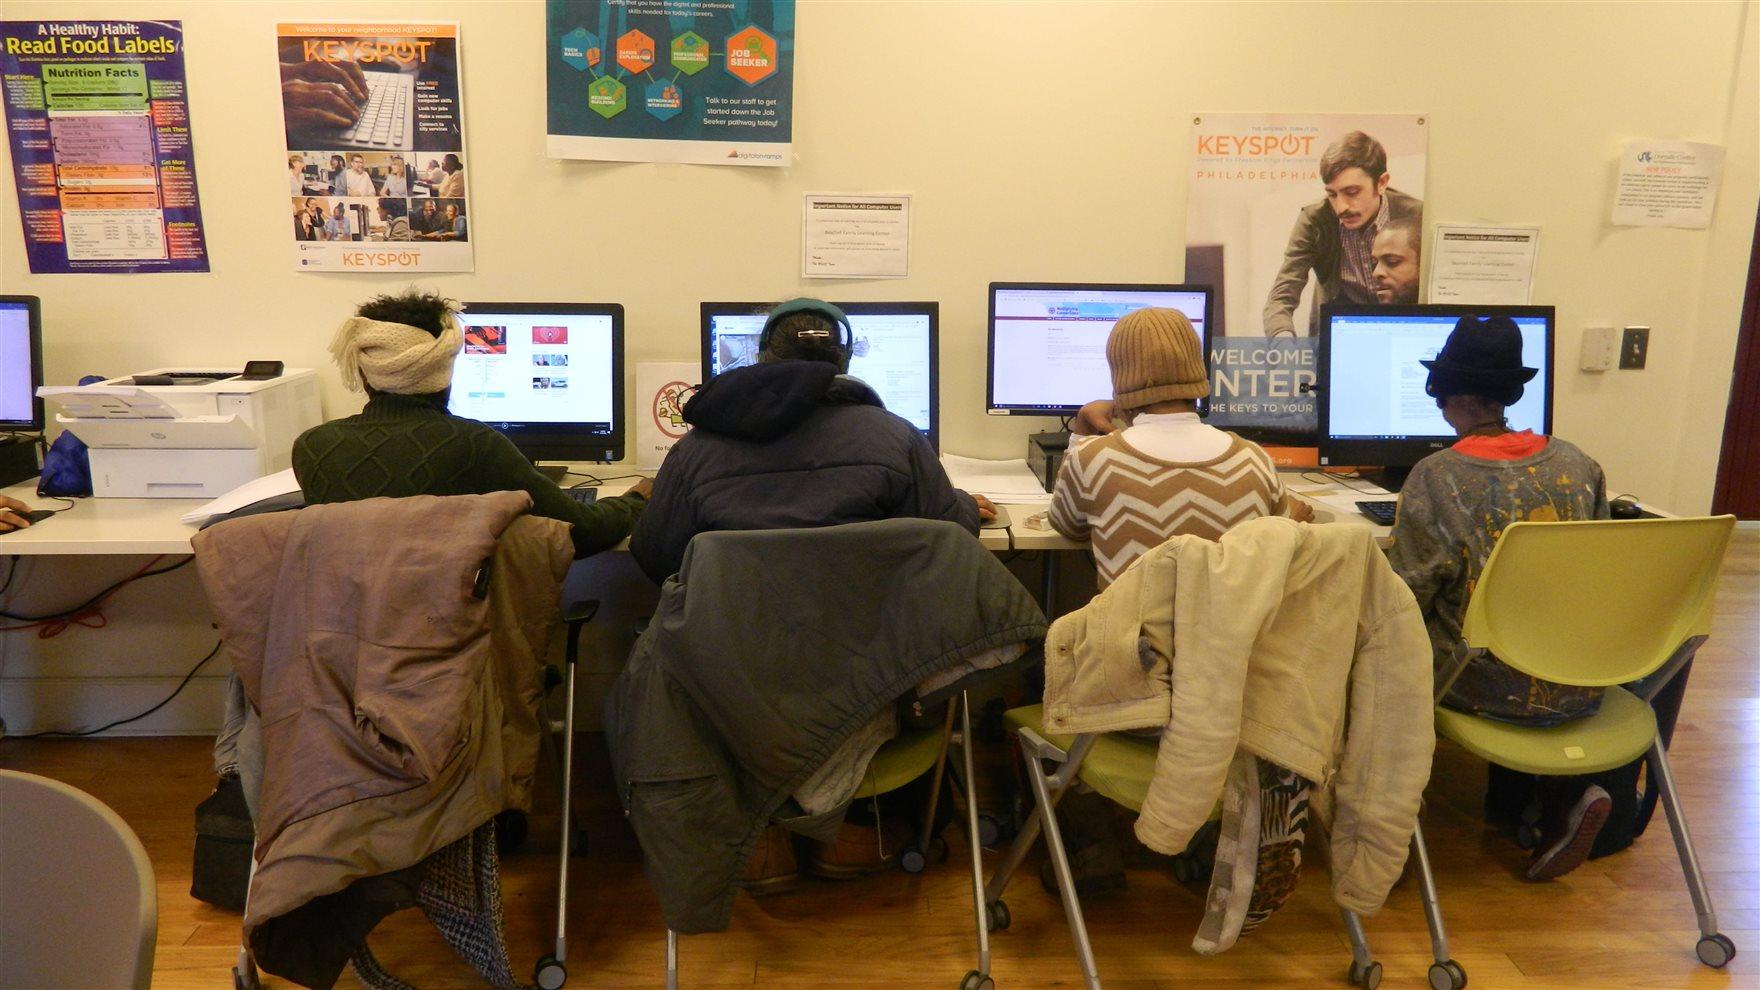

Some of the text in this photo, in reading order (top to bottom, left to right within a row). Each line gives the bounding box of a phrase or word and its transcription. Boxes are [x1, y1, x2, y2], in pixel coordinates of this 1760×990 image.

[38, 25, 140, 38] A Healthy Habit:
[337, 27, 352, 35] your
[353, 27, 400, 35] neighborhood
[7, 37, 174, 54] Read Food Labels
[303, 41, 431, 63] KEYSPOT
[731, 58, 768, 67] SEEKER
[48, 68, 139, 77] Nutrition Facts
[765, 99, 777, 107] get
[762, 109, 776, 117] Job
[727, 119, 757, 127] pathway
[757, 119, 778, 127] today!
[1197, 134, 1315, 155] KEYSPOT
[1196, 171, 1318, 180] PHILADELPHIA
[343, 253, 421, 266] KEYSPOT
[1210, 349, 1313, 365] WELCOME
[1214, 370, 1317, 397] NTER
[1210, 404, 1313, 413] HE KEYS TO YOUR
